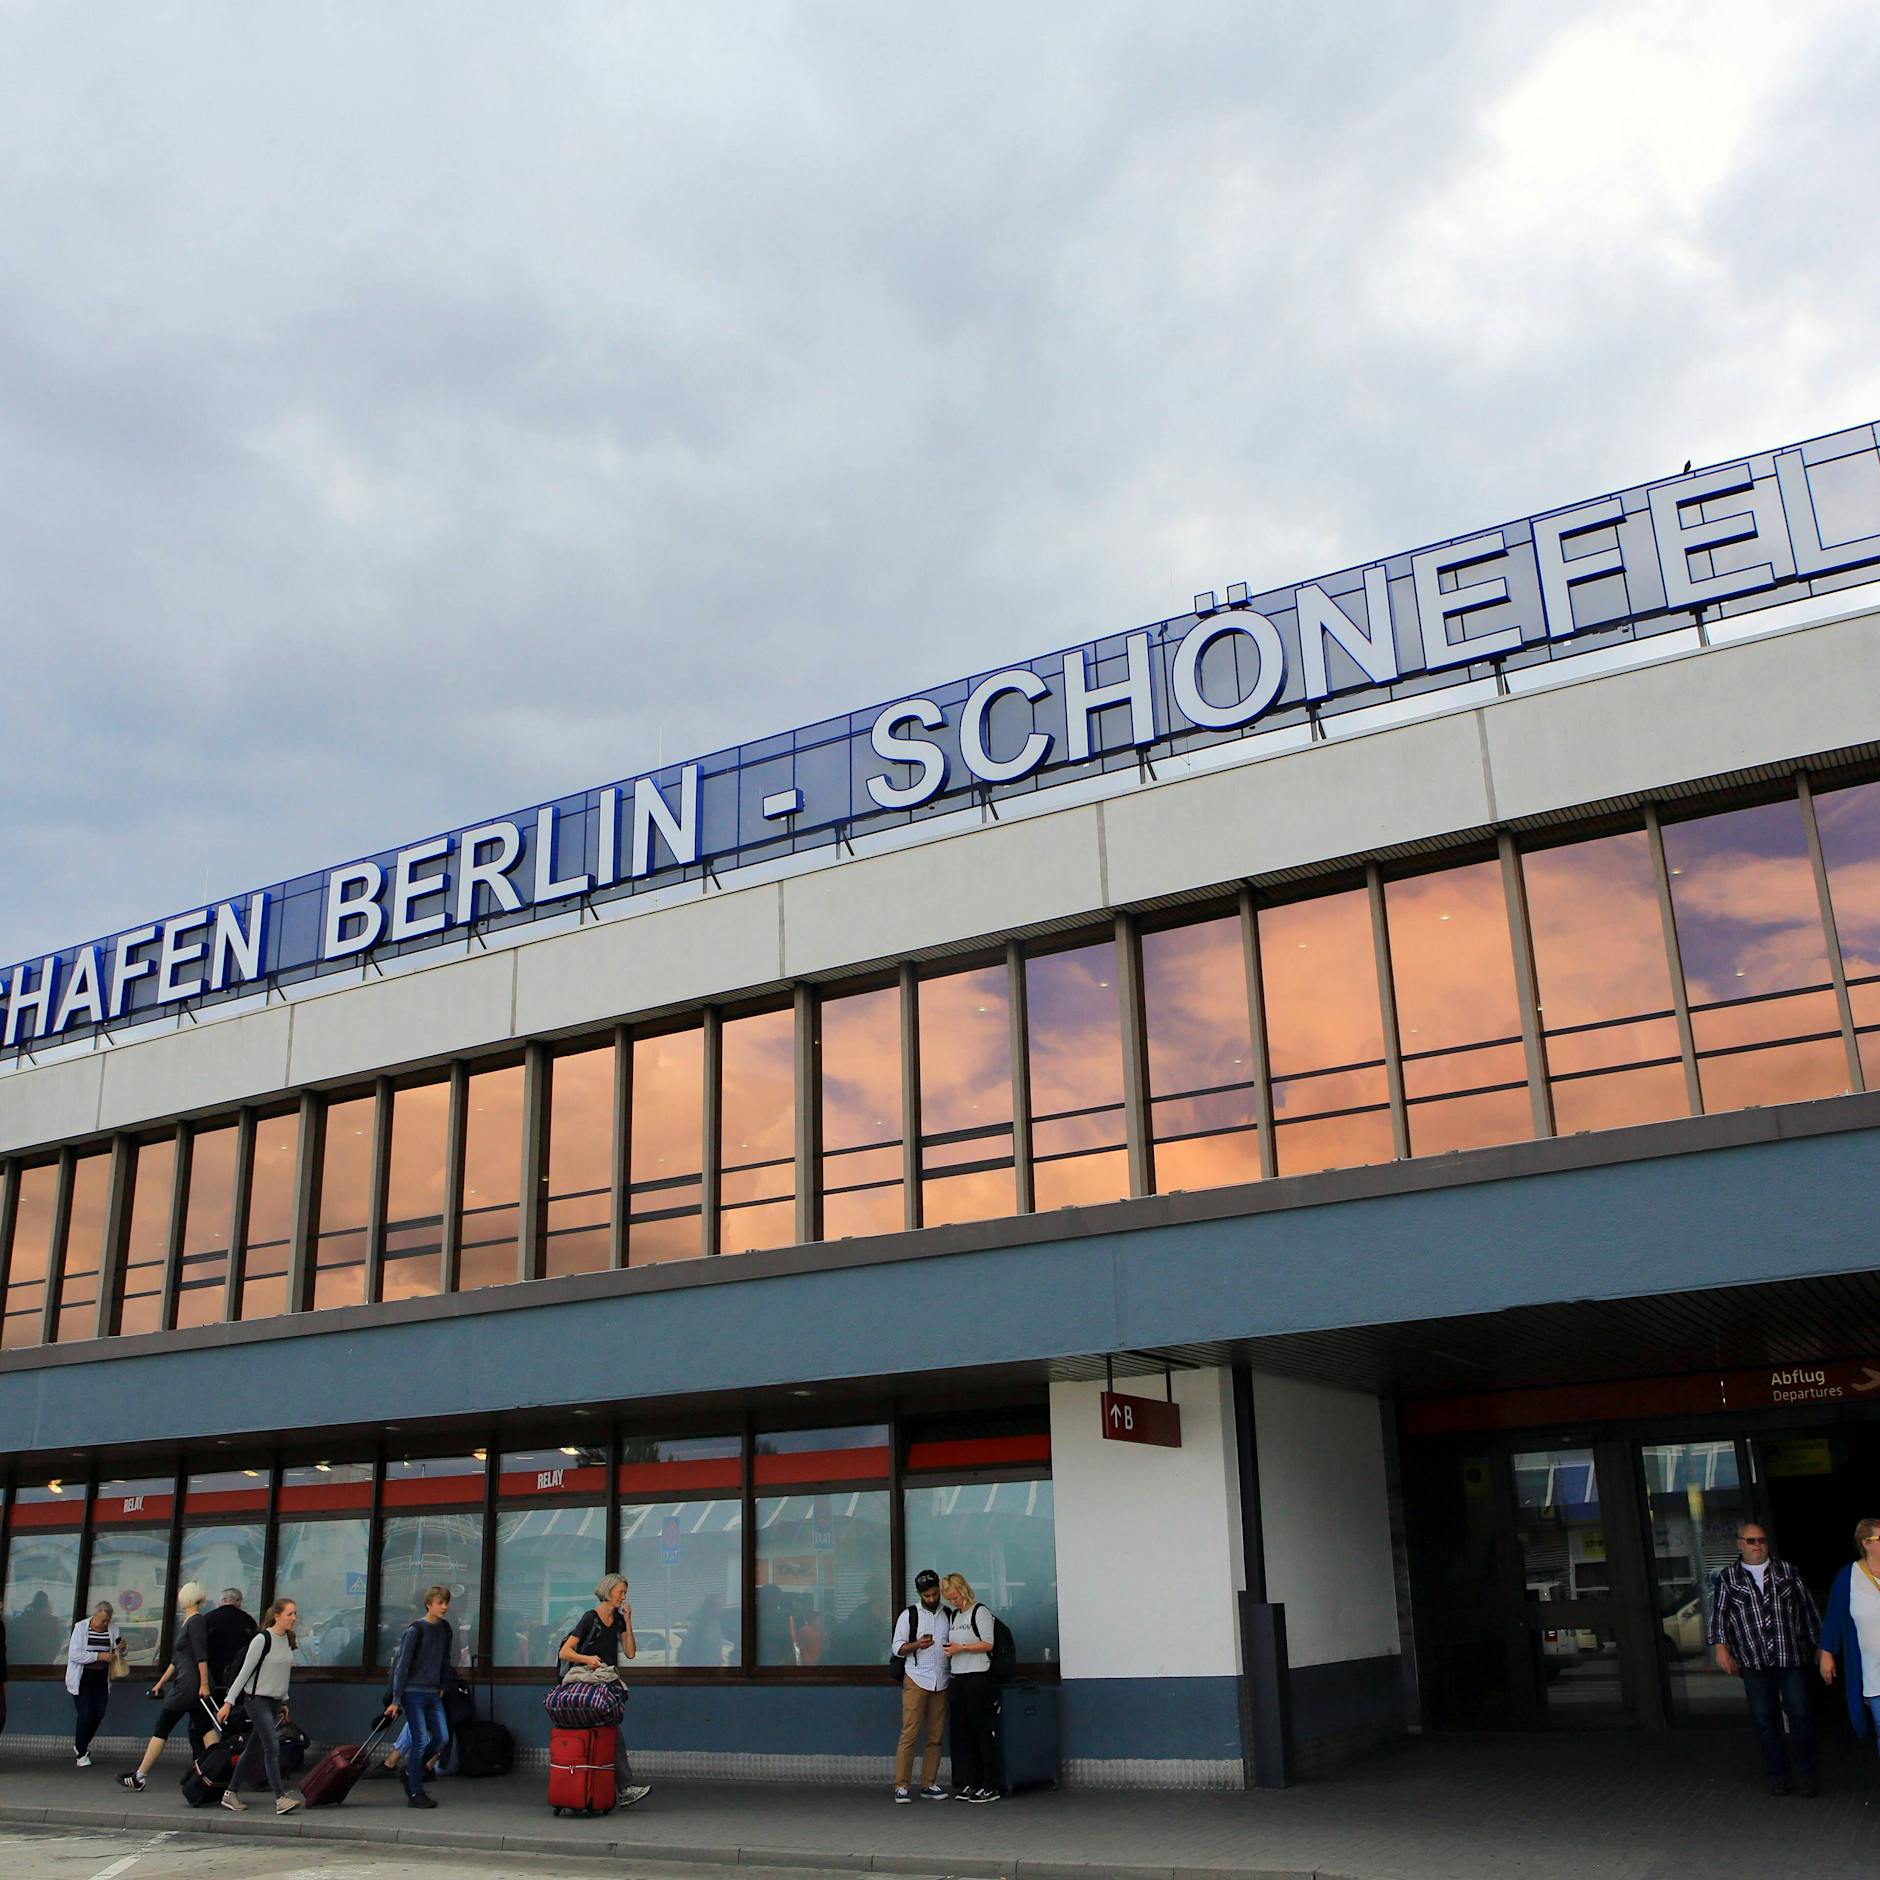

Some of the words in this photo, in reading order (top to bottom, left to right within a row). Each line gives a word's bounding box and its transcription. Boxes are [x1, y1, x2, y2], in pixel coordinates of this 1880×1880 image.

[0, 891, 272, 1048] HAFEN
[323, 763, 704, 962] BERLIN
[866, 449, 1880, 810] SCHÖNEFEL
[1771, 1369, 1825, 1386] Abflug
[1773, 1386, 1844, 1403] Departures
[1123, 1404, 1134, 1431] B
[537, 1468, 564, 1490] RELAY
[123, 1495, 144, 1513] RELAY
